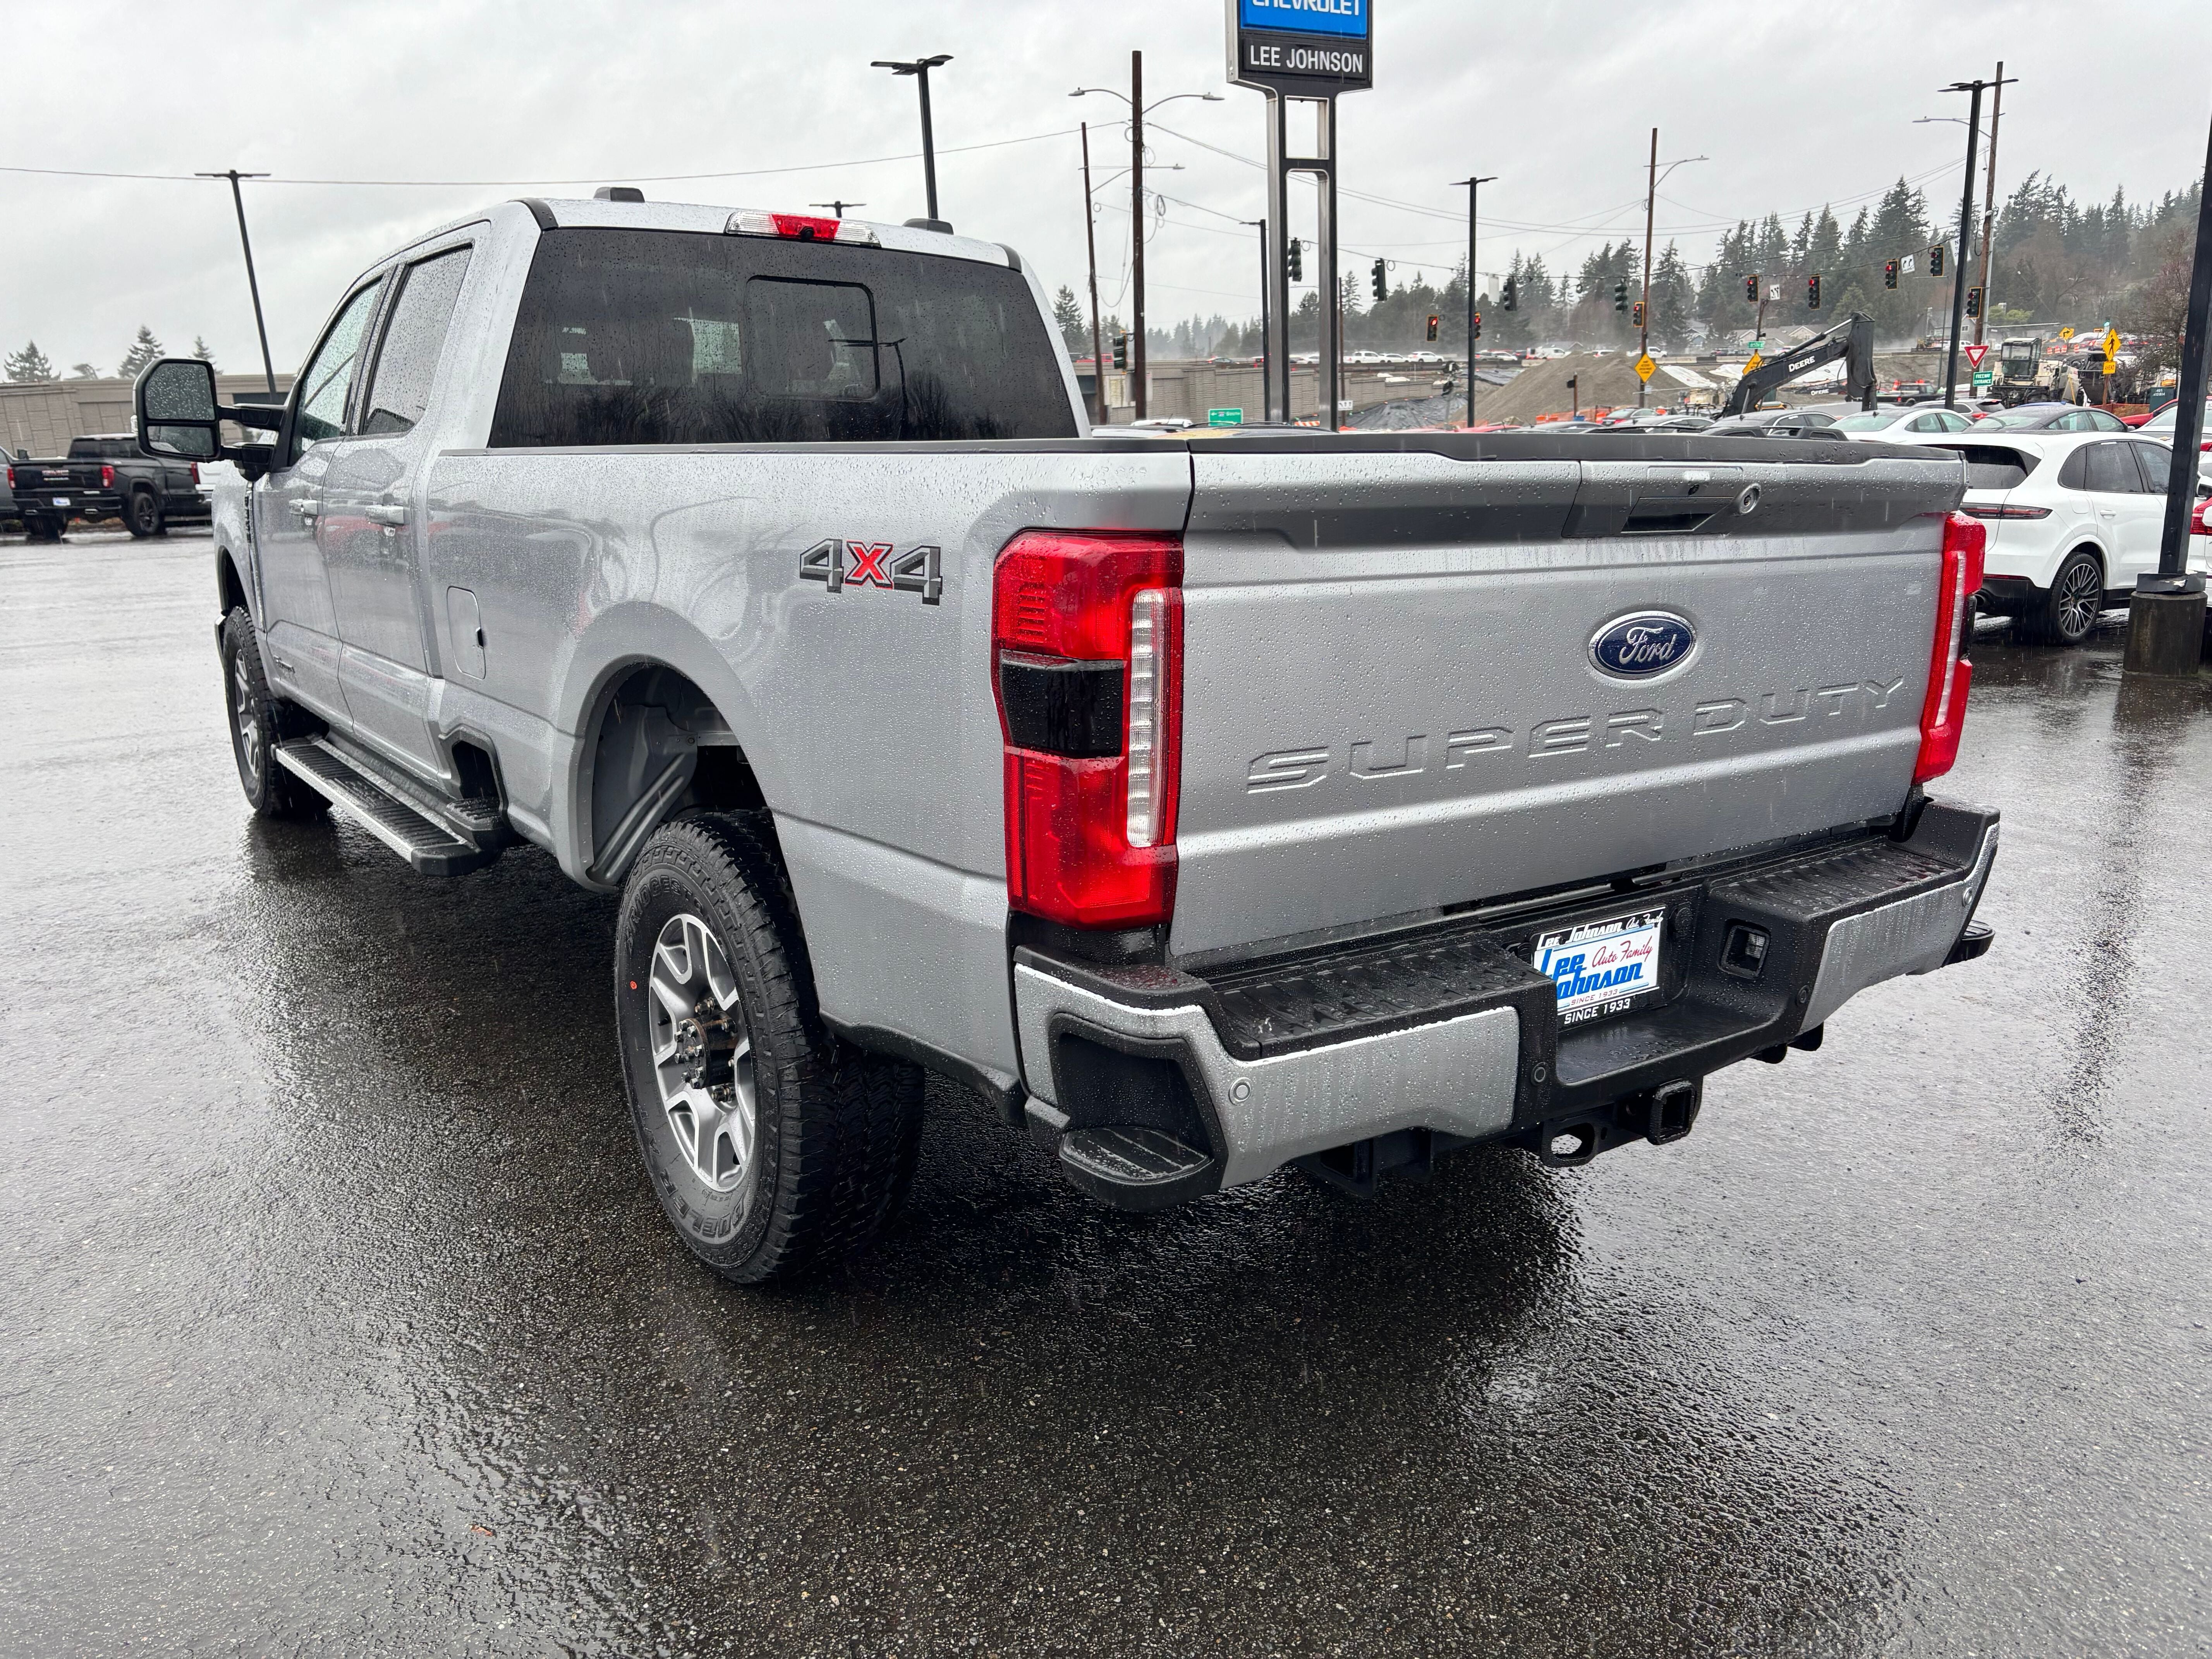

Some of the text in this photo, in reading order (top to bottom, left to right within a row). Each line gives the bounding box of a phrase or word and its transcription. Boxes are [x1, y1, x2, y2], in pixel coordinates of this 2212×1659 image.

[1250, 45, 1363, 73] LEE JOHNSON
[1788, 356, 1815, 372] DEERE
[1619, 626, 1677, 665] Ford
[1247, 675, 1904, 794] SUPER DUTY
[1565, 921, 1623, 943] Johnson
[1540, 948, 1587, 980] Lee
[1592, 935, 1653, 967] Auto Family
[1564, 998, 1631, 1024] SINCE 1933
[1571, 989, 1618, 1005] SINCE 1933
